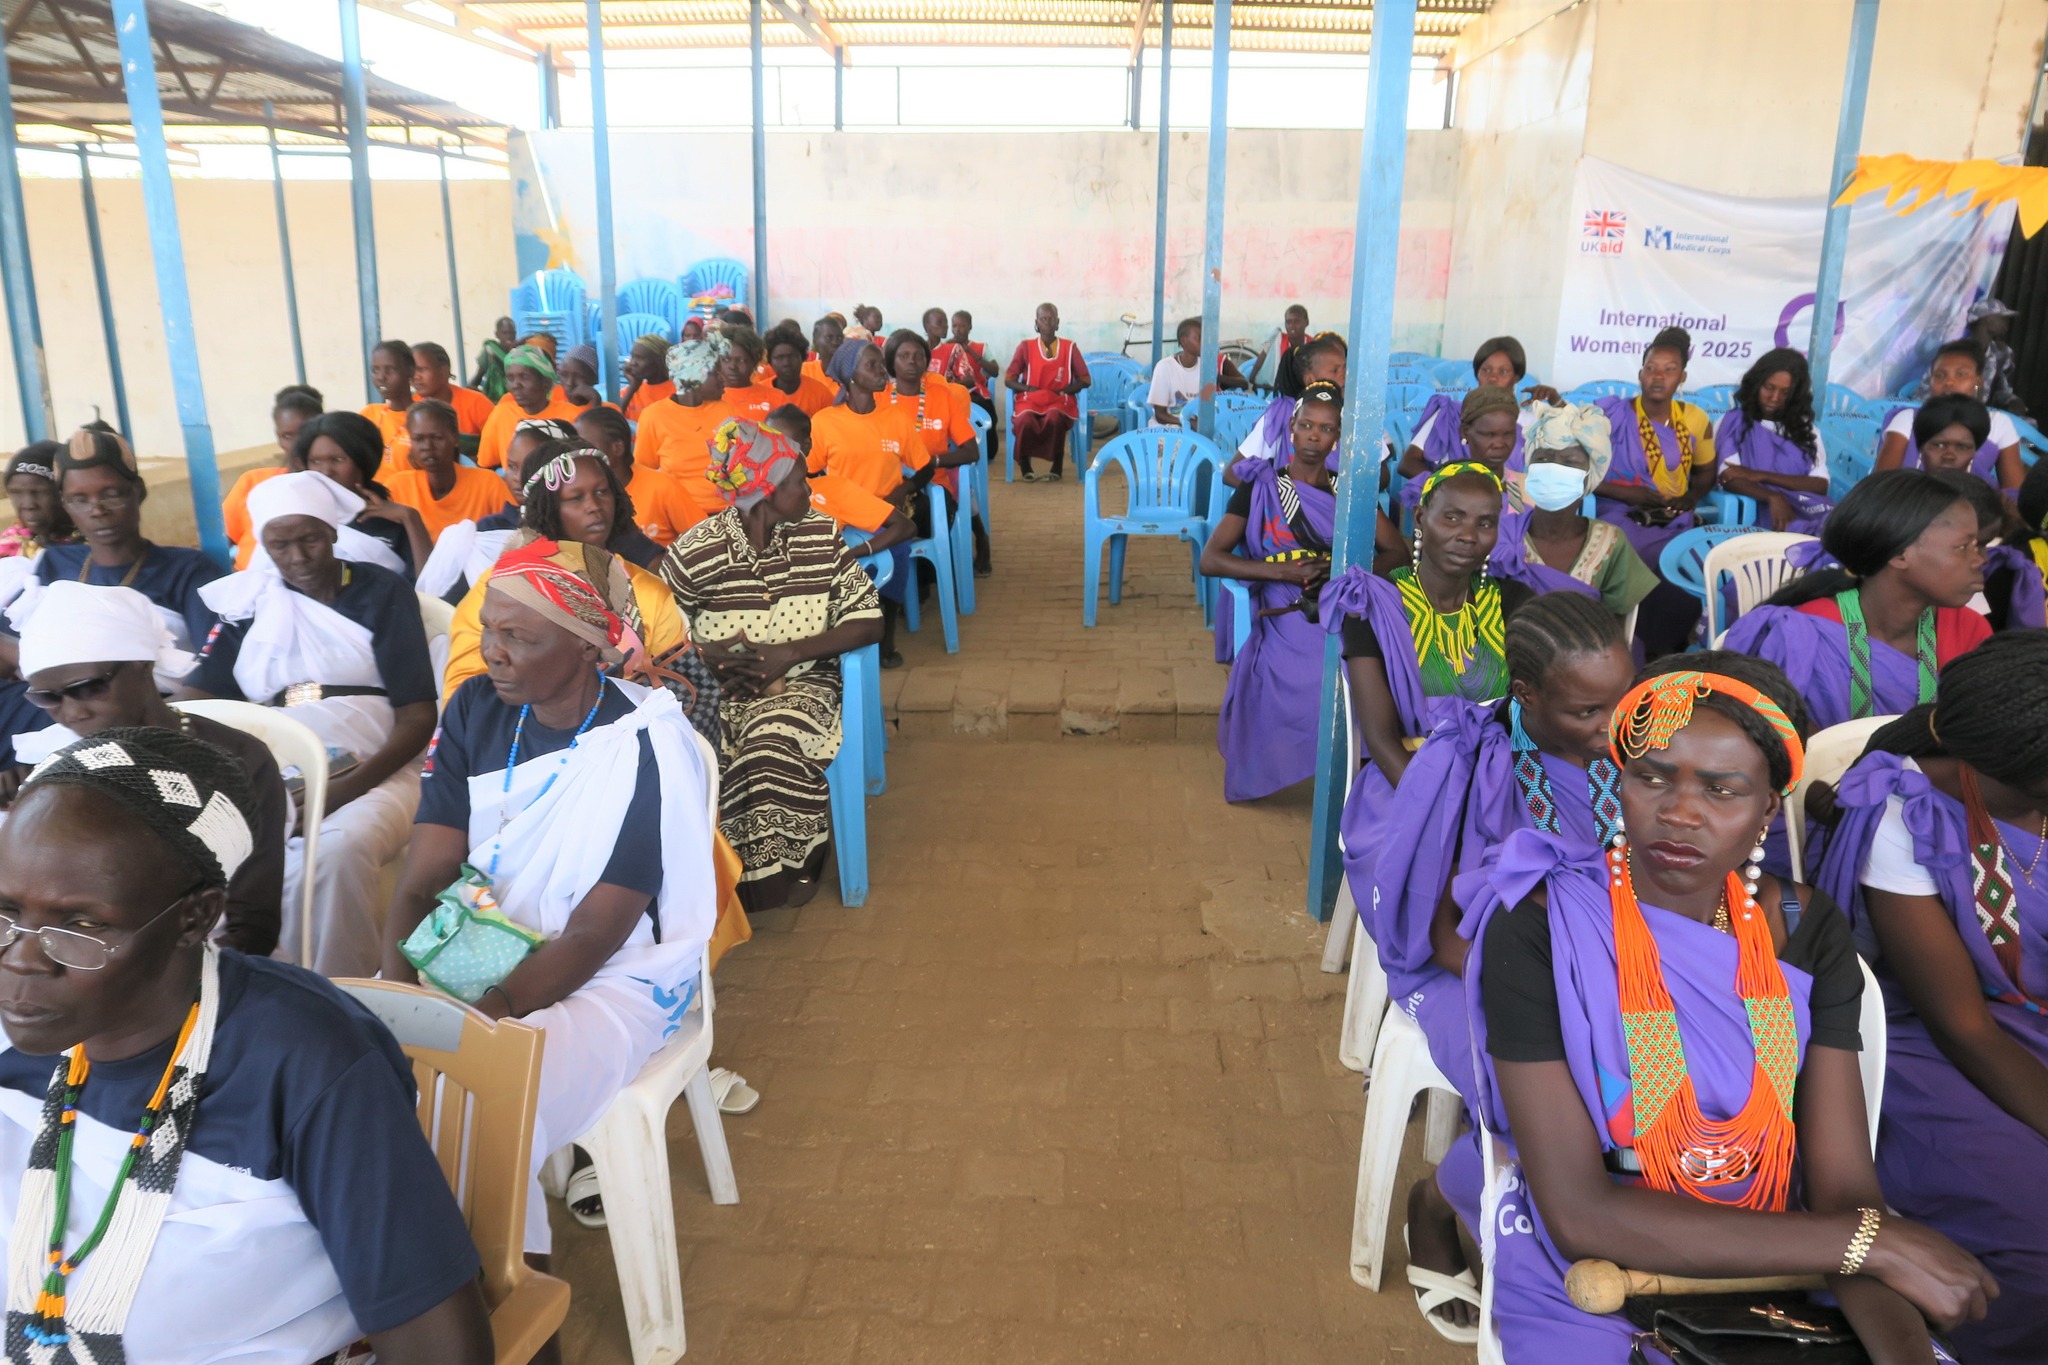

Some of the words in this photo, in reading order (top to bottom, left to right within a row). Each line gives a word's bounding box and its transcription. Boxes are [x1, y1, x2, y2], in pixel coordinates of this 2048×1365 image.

[1675, 232, 1729, 243] International
[1673, 242, 1705, 252] Medical
[1707, 244, 1731, 255] Corps
[1600, 308, 1727, 331] International
[1701, 341, 1752, 359] 2025
